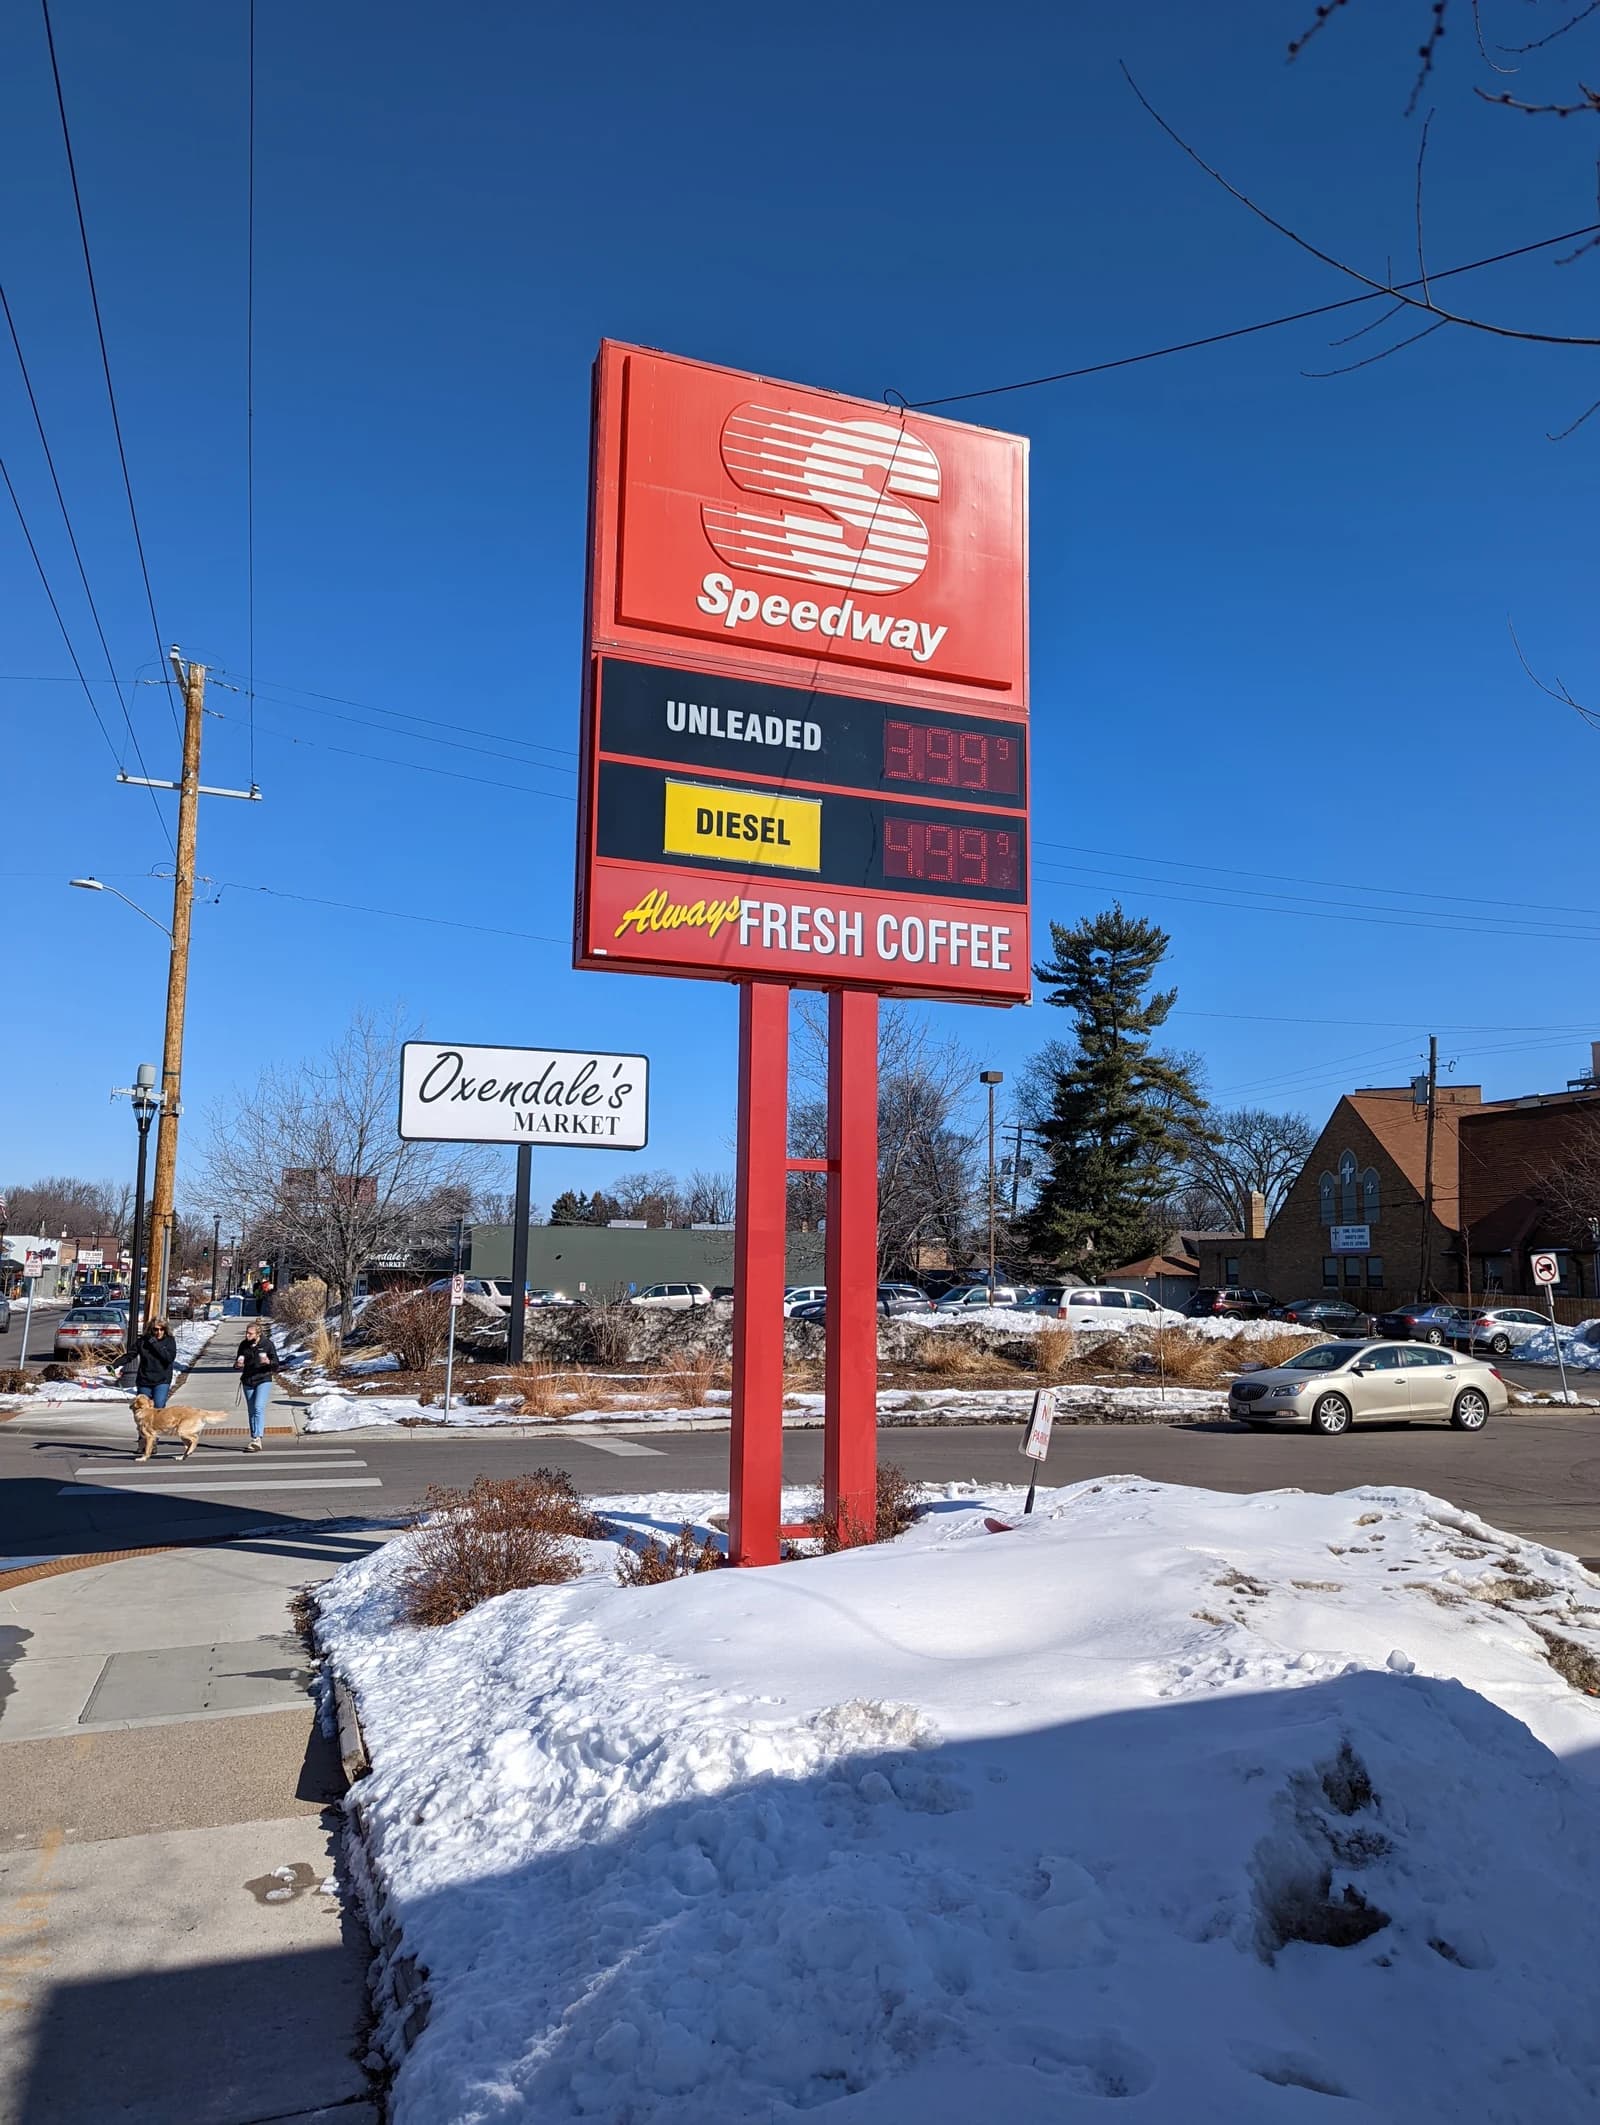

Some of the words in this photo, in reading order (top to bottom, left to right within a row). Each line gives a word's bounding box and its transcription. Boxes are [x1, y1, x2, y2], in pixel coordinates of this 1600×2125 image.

[696, 572, 948, 662] Speedway
[666, 700, 822, 751] UNLEADED
[696, 807, 791, 846] DIESEL
[614, 888, 744, 938] Always
[739, 899, 864, 957] FRESH
[877, 914, 1012, 971] COFFEE
[419, 1051, 632, 1109] Oxendale's
[512, 1112, 620, 1136] MARKET
